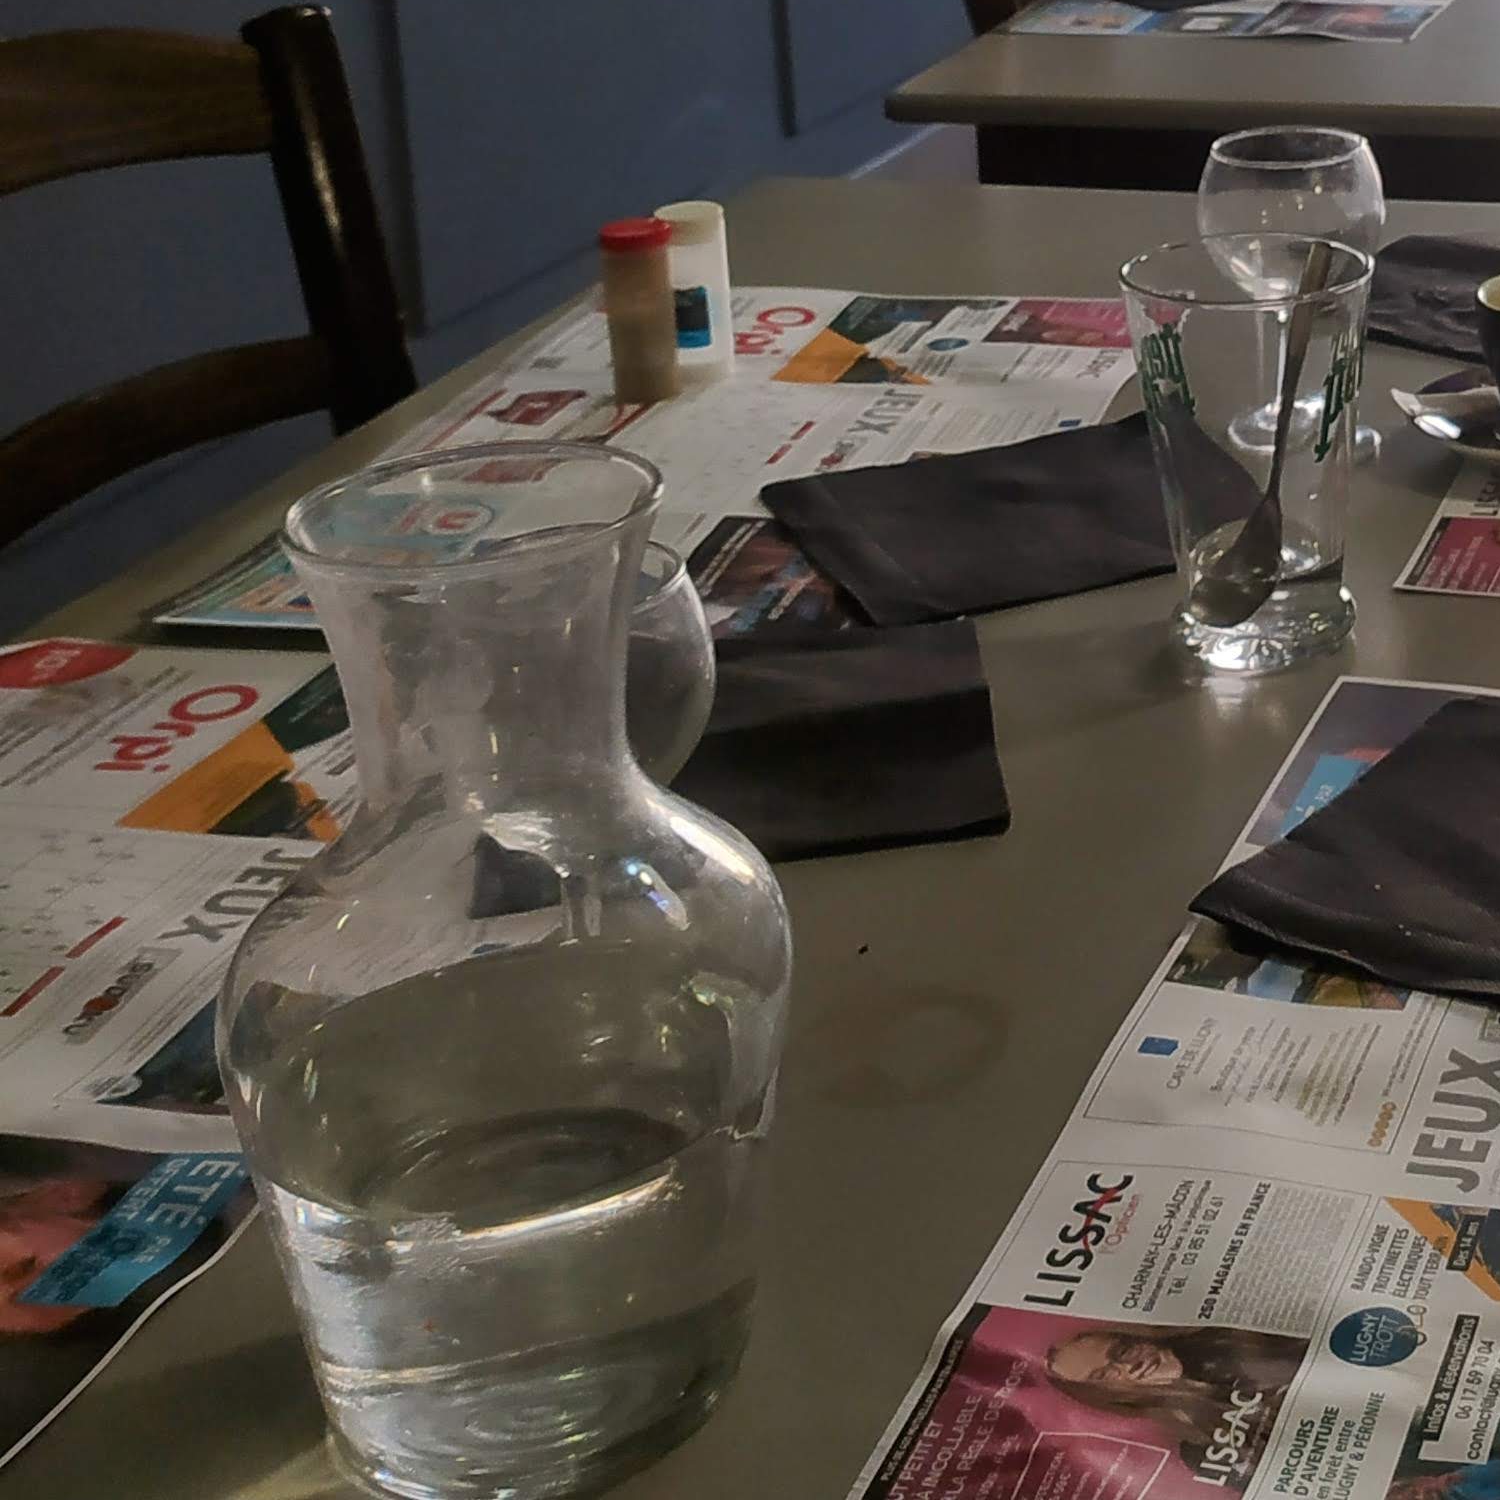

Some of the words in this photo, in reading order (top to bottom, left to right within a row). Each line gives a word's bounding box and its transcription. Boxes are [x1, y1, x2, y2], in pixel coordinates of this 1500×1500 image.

[92, 684, 260, 773] Orpi
[1238, 1181, 1272, 1221] FRANCE
[1022, 1171, 1135, 1308] LISSAC
[1232, 1222, 1252, 1237] EN
[1204, 1238, 1245, 1295] MAGASINS
[1350, 1224, 1391, 1291] RANDO-VIGNE
[1369, 1226, 1410, 1295] TROTTINETTES
[1351, 1312, 1381, 1362] LUGNY
[1437, 1317, 1477, 1390] réservations
[1474, 1340, 1496, 1354] 04
[1434, 1392, 1451, 1403] &
[1458, 1388, 1479, 1403] 17
[1462, 1370, 1484, 1385] 59
[1191, 1387, 1264, 1487] LISSAC
[1333, 1419, 1356, 1453] entre
[1423, 1404, 1448, 1434] Infos
[1453, 1405, 1473, 1420] 06
[900, 1439, 933, 1480] PETIT
[924, 1419, 944, 1438] ET
[921, 1394, 983, 1488] INCOLLABLE
[1273, 1418, 1316, 1493] PARCOURS
[1296, 1404, 1340, 1497] D'AVENTURE
[1332, 1463, 1363, 1500] LUGNY
[1350, 1391, 1386, 1448] PÉRONNE
[1316, 1485, 1333, 1499] en
[1321, 1455, 1348, 1483] forêt
